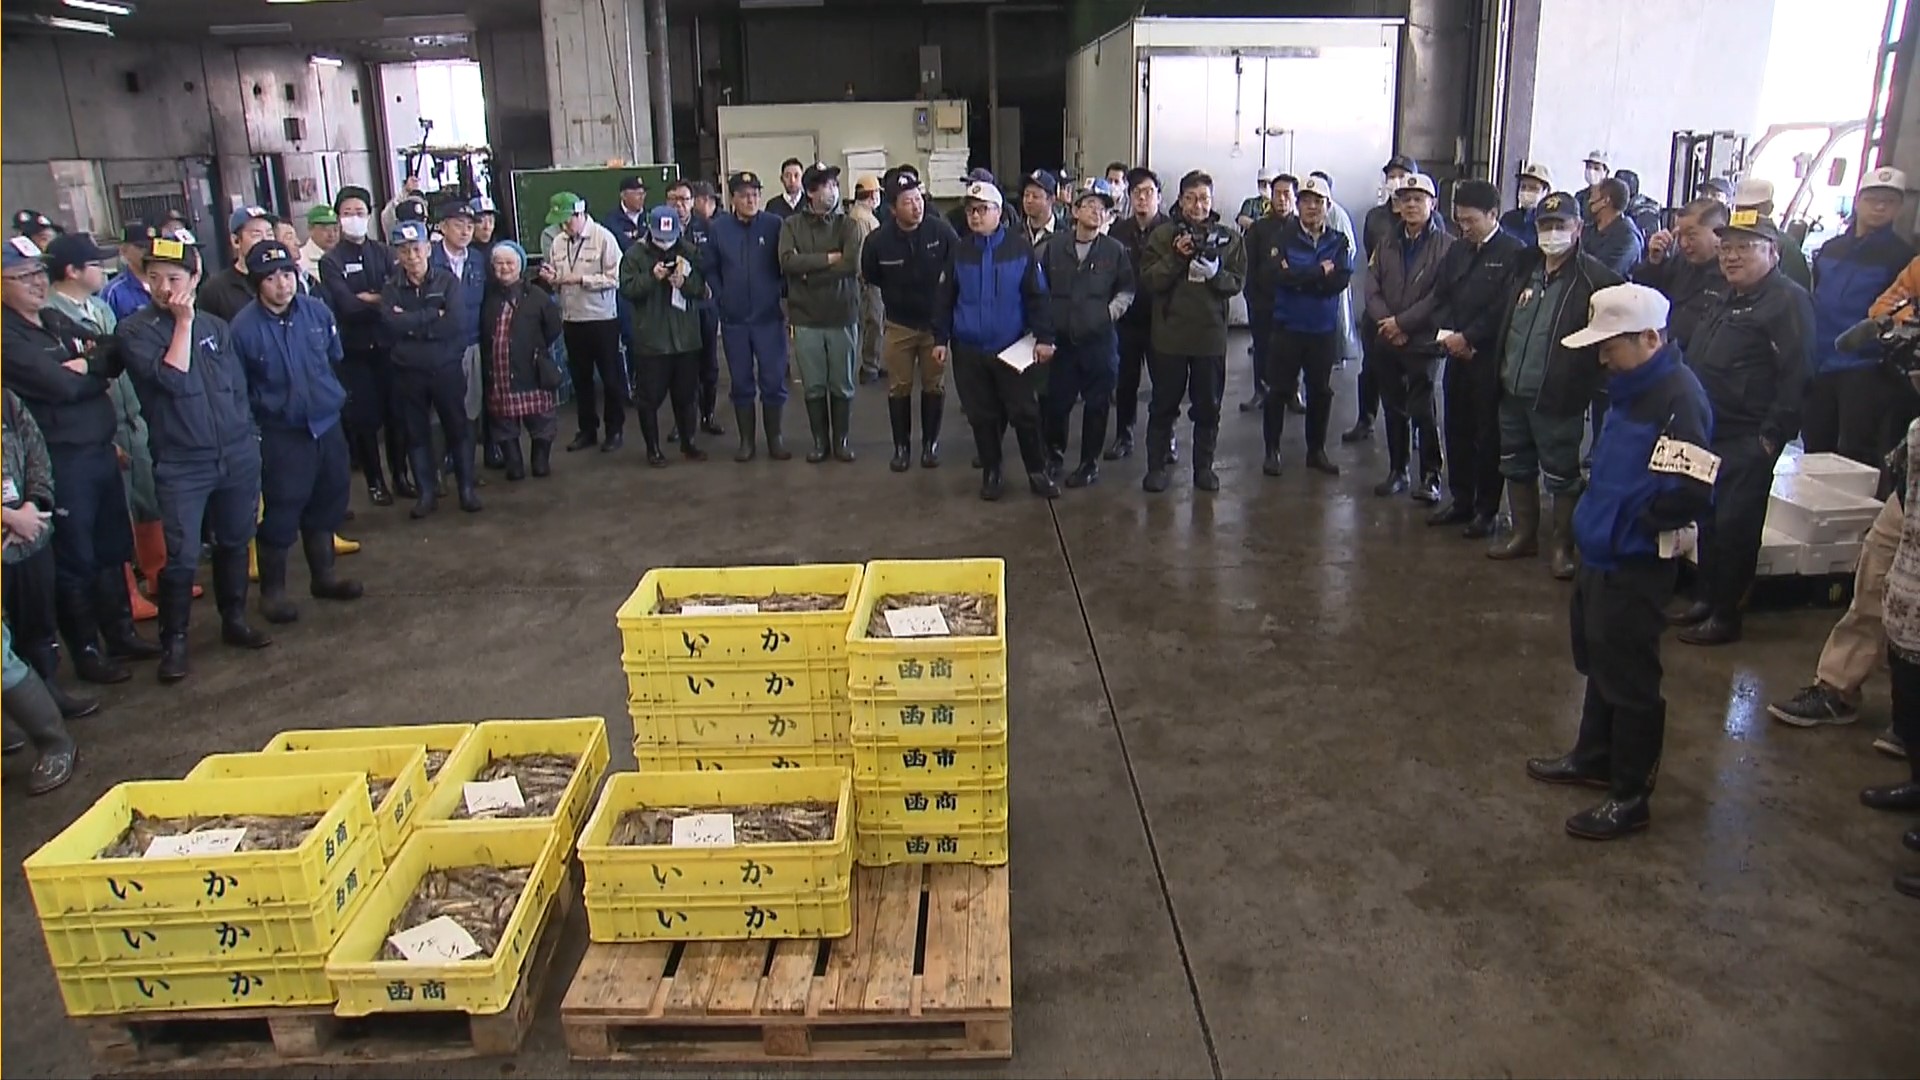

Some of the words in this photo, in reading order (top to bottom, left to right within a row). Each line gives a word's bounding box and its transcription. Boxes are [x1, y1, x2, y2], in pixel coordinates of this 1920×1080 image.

[682, 627, 791, 658] いか
[687, 671, 795, 695] いか
[692, 713, 798, 737] いか
[651, 859, 773, 884] いか
[107, 870, 239, 900] いか
[656, 905, 778, 929] いか
[120, 920, 251, 949] いか
[135, 971, 263, 998] いか
